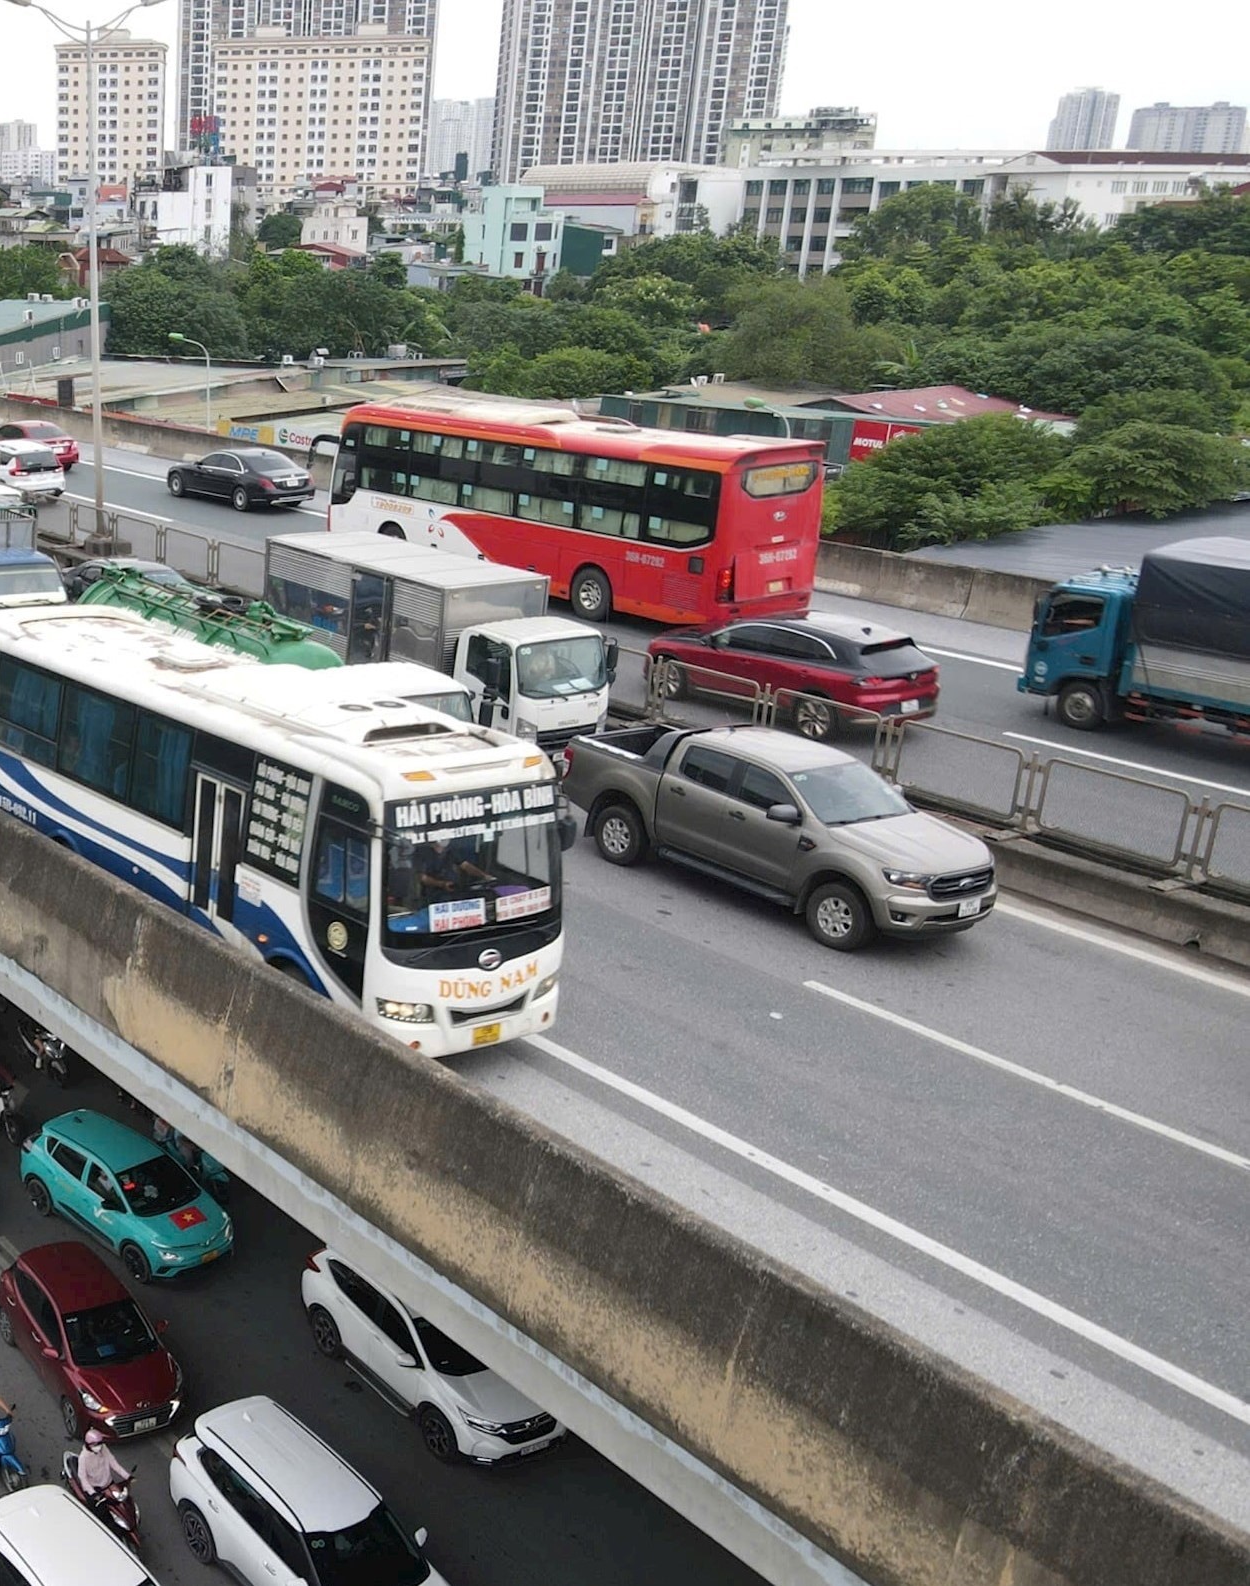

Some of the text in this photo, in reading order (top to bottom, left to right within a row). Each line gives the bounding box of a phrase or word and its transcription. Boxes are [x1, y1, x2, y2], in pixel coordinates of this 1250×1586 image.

[229, 427, 259, 440] MPE
[289, 432, 313, 446] Castr
[853, 437, 884, 449] MOTUL
[395, 800, 428, 828] HẢI
[523, 784, 555, 809] BÌNH
[439, 960, 538, 999] DŨNG NAM
